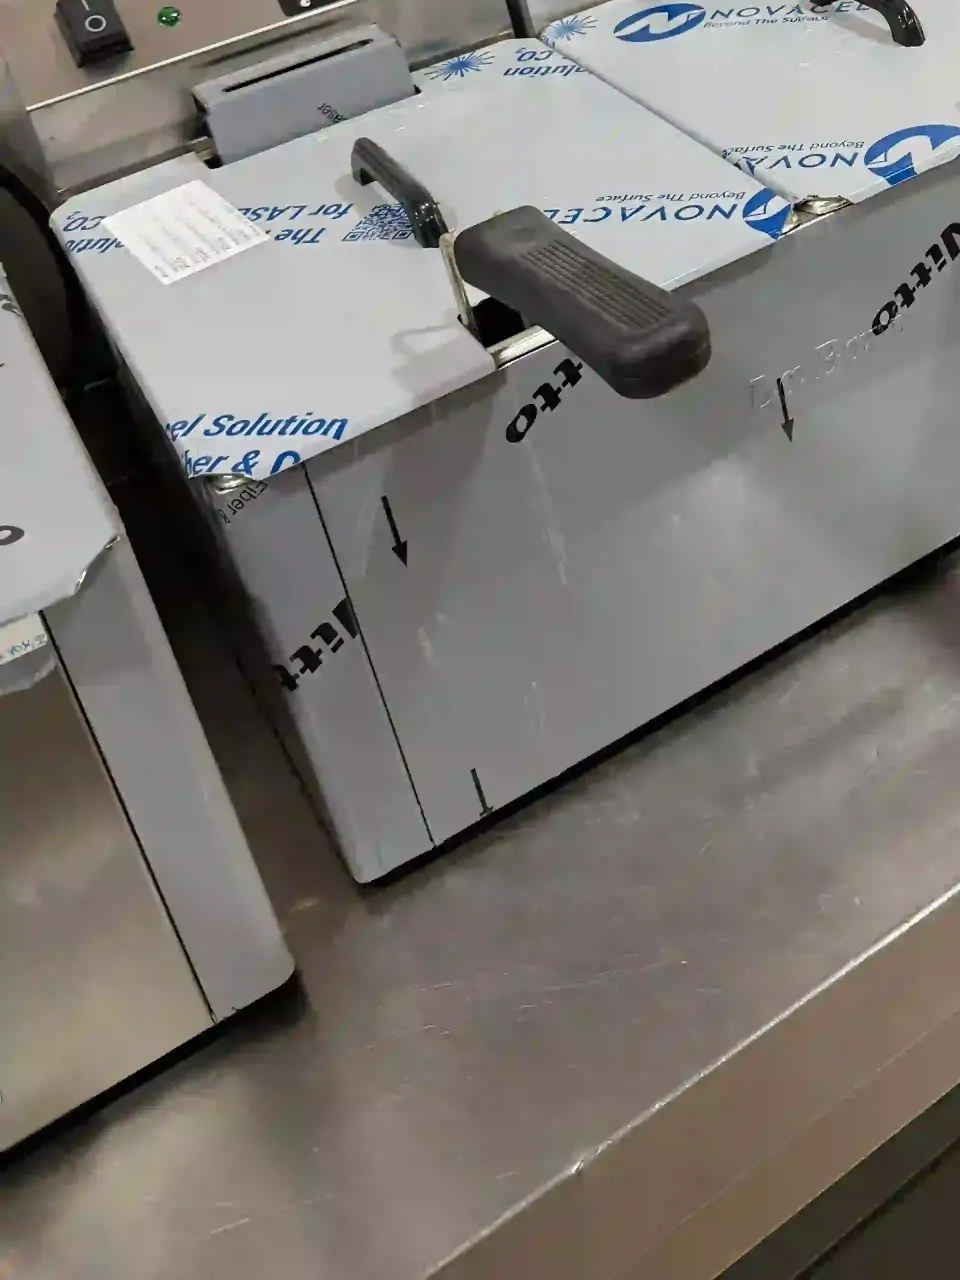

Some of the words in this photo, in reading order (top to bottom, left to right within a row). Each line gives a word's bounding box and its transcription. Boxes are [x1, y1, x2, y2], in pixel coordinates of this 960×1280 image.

[754, 17, 779, 25] The
[778, 143, 805, 152] The
[809, 140, 865, 151] Beyond
[742, 151, 859, 175] NOVA
[595, 193, 652, 204] Surface
[656, 192, 684, 202] The
[687, 190, 747, 202] Beyond
[307, 203, 355, 220] for
[542, 203, 738, 224] NOVACEL
[274, 227, 326, 246] The
[505, 358, 583, 443] tto
[202, 411, 349, 441] Solution
[230, 449, 261, 476] &
